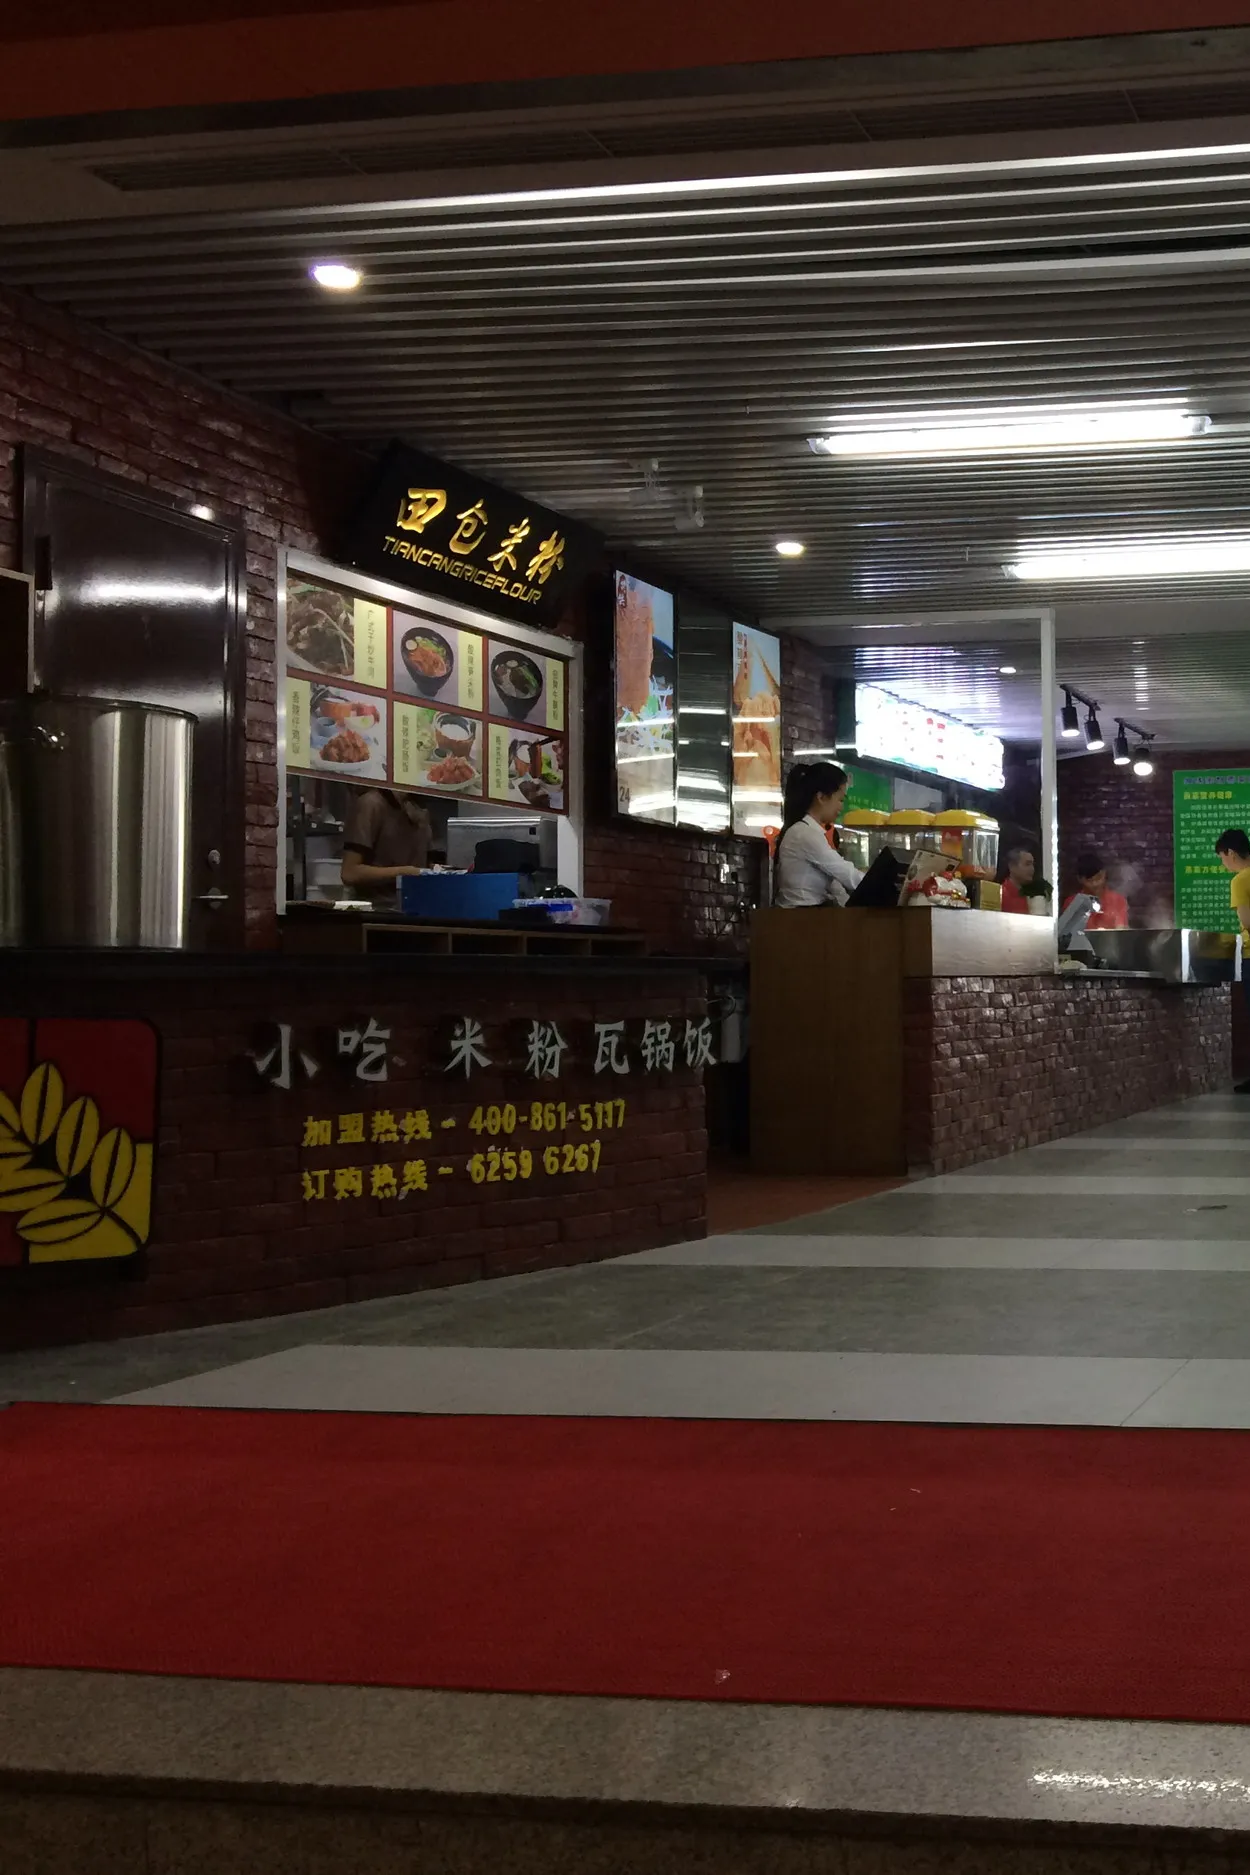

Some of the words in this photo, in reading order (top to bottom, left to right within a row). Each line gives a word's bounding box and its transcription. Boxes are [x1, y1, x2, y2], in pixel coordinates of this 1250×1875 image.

[383, 536, 542, 605] TIANCANGRICEFLOUR
[302, 1109, 432, 1147] 加盟热线
[301, 1159, 430, 1201] 订购热线
[470, 1149, 533, 1184] 6259
